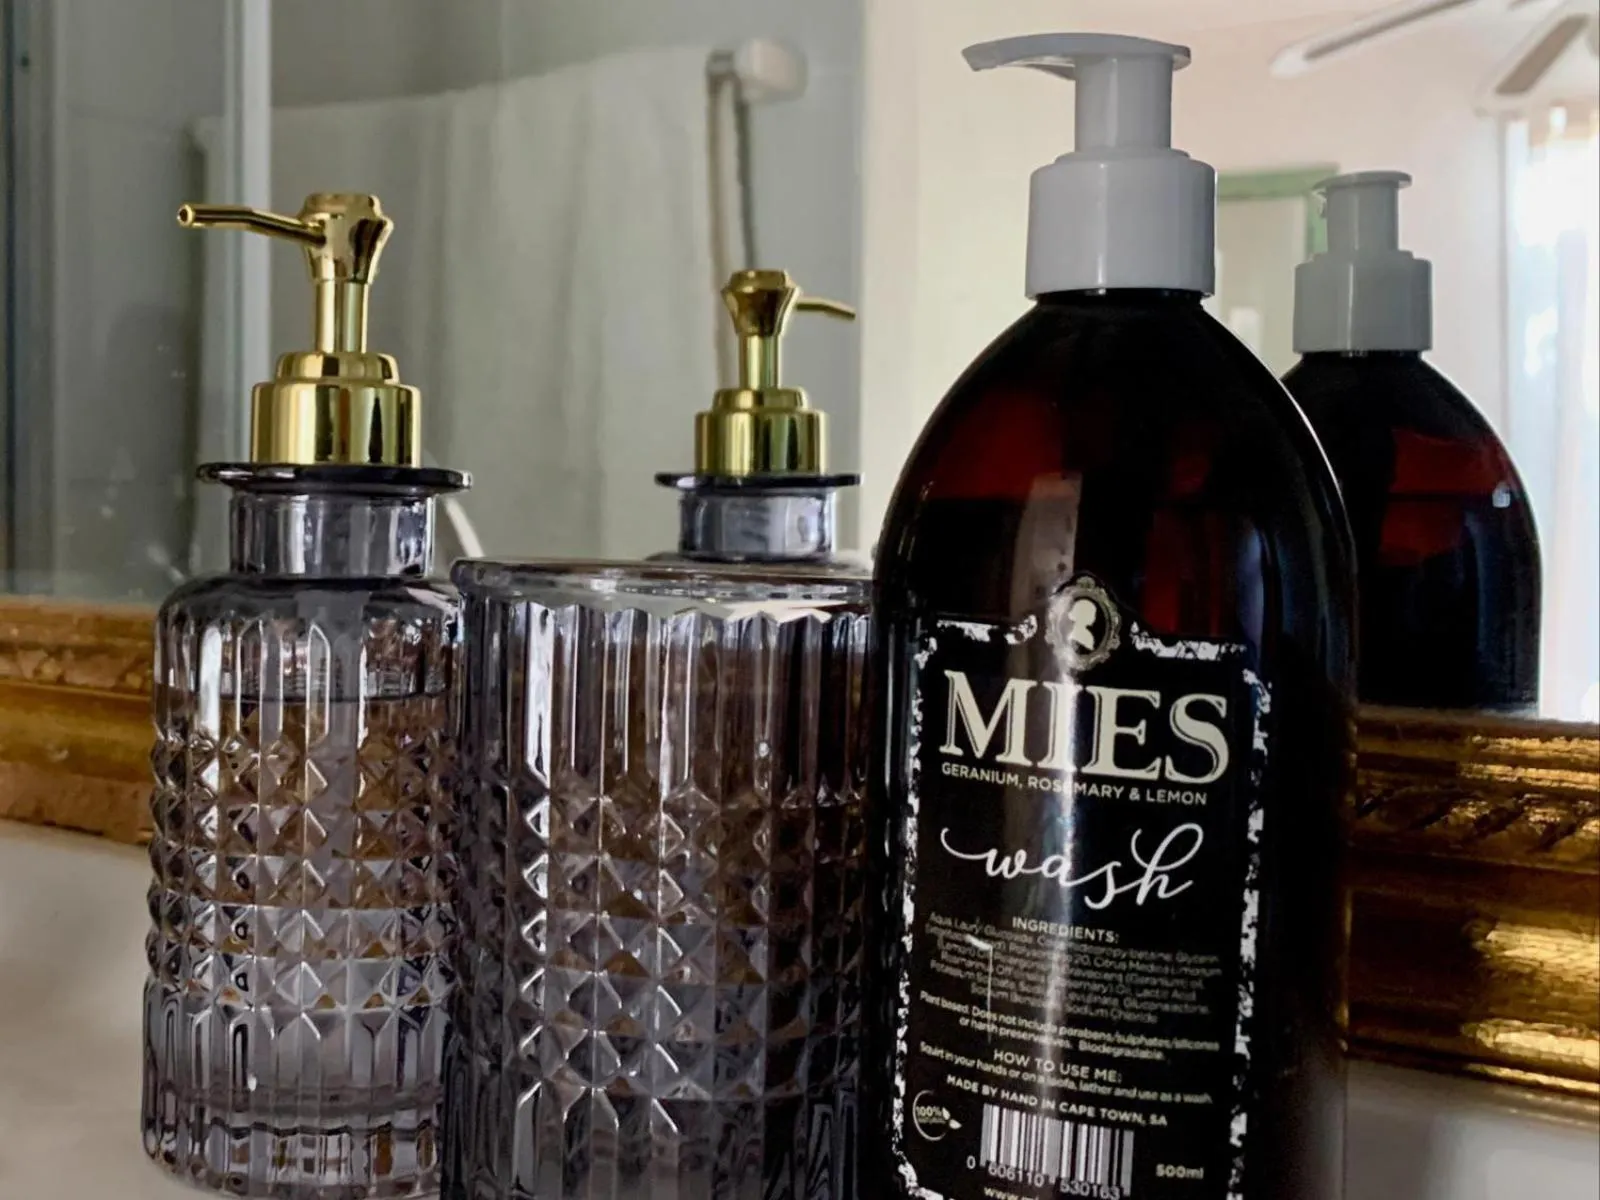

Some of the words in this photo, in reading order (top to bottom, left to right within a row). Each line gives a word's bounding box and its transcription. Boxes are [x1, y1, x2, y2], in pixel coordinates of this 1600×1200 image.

[939, 669, 1229, 784] MIES
[941, 761, 1023, 790] GERANIUM,
[1027, 774, 1124, 802] ROSEMARY
[1128, 786, 1141, 801] &
[1145, 788, 1207, 806] LEMON
[940, 822, 1204, 909] wash
[1012, 916, 1120, 944] INGREDIENTS:
[970, 1017, 998, 1033] harsh
[971, 1005, 997, 1022] Does
[998, 1013, 1016, 1026] not
[953, 1054, 976, 1069] your
[976, 1058, 1008, 1076] hands
[1008, 1069, 1021, 1079] or
[1114, 1085, 1137, 1099] and
[993, 1048, 1031, 1067] HOW
[1035, 1057, 1055, 1073] TO
[1060, 1062, 1090, 1080] USE
[946, 1074, 979, 1093] MADE
[981, 1083, 999, 1097] BY
[1001, 1088, 1038, 1106] HAND
[1041, 1098, 1056, 1110] IN
[1059, 1101, 1096, 1117] CAPE
[1099, 1106, 1147, 1127] TOWN,
[1149, 1112, 1168, 1127] SA
[965, 1155, 976, 1170] 0
[988, 1161, 1045, 1188] 606110
[1155, 1163, 1205, 1180] 500ml
